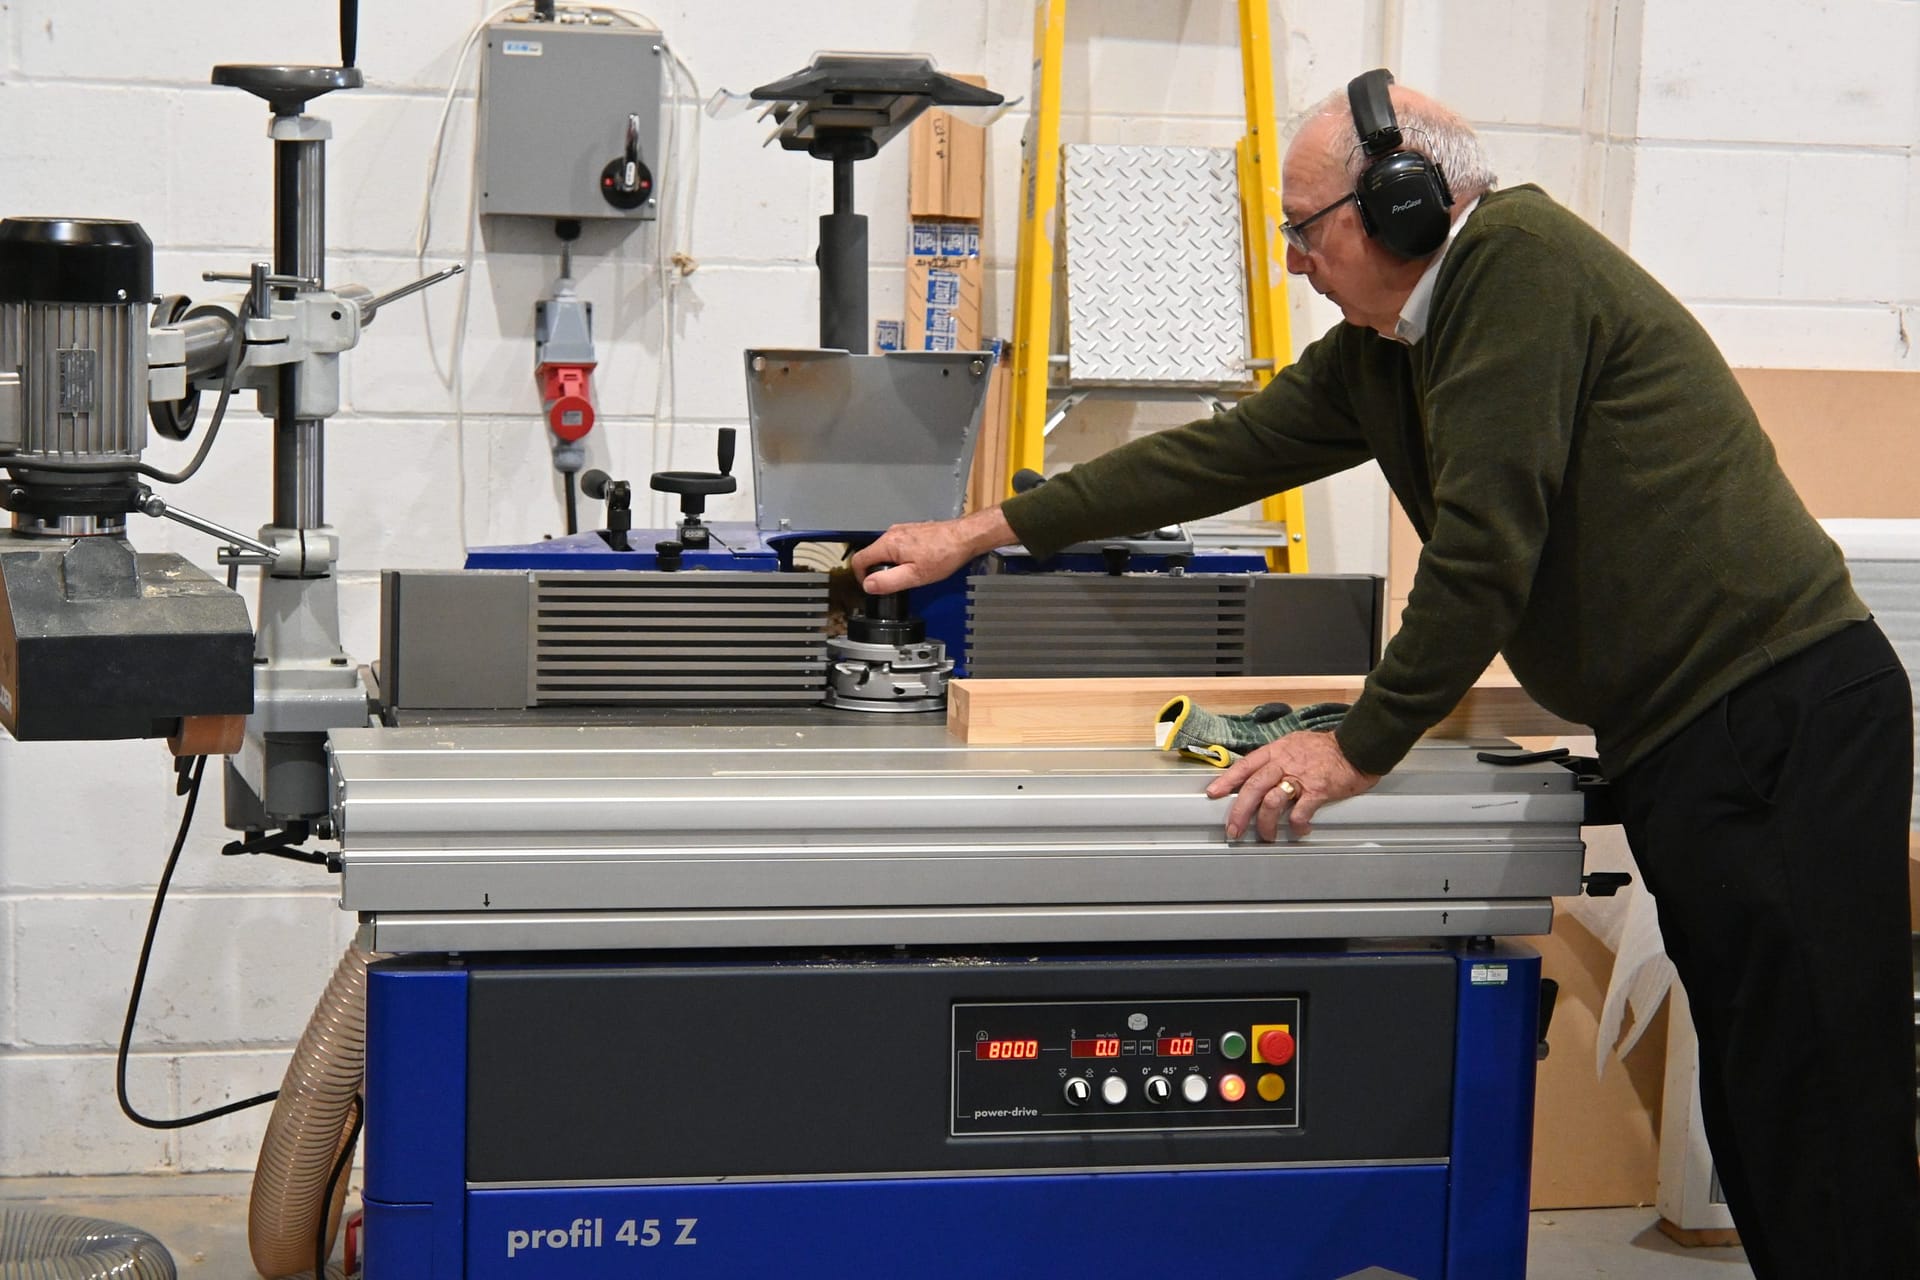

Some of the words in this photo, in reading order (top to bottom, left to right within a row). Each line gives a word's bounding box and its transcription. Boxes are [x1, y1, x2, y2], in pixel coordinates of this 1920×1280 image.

[1392, 198, 1422, 214] ProCase
[989, 1041, 1037, 1058] 8000
[1095, 1040, 1120, 1056] 0.0
[1170, 1038, 1194, 1055] 0.0
[974, 1107, 1038, 1120] power-drive
[507, 1218, 603, 1258] profil
[615, 1218, 661, 1248] 45
[673, 1217, 698, 1246] Z
